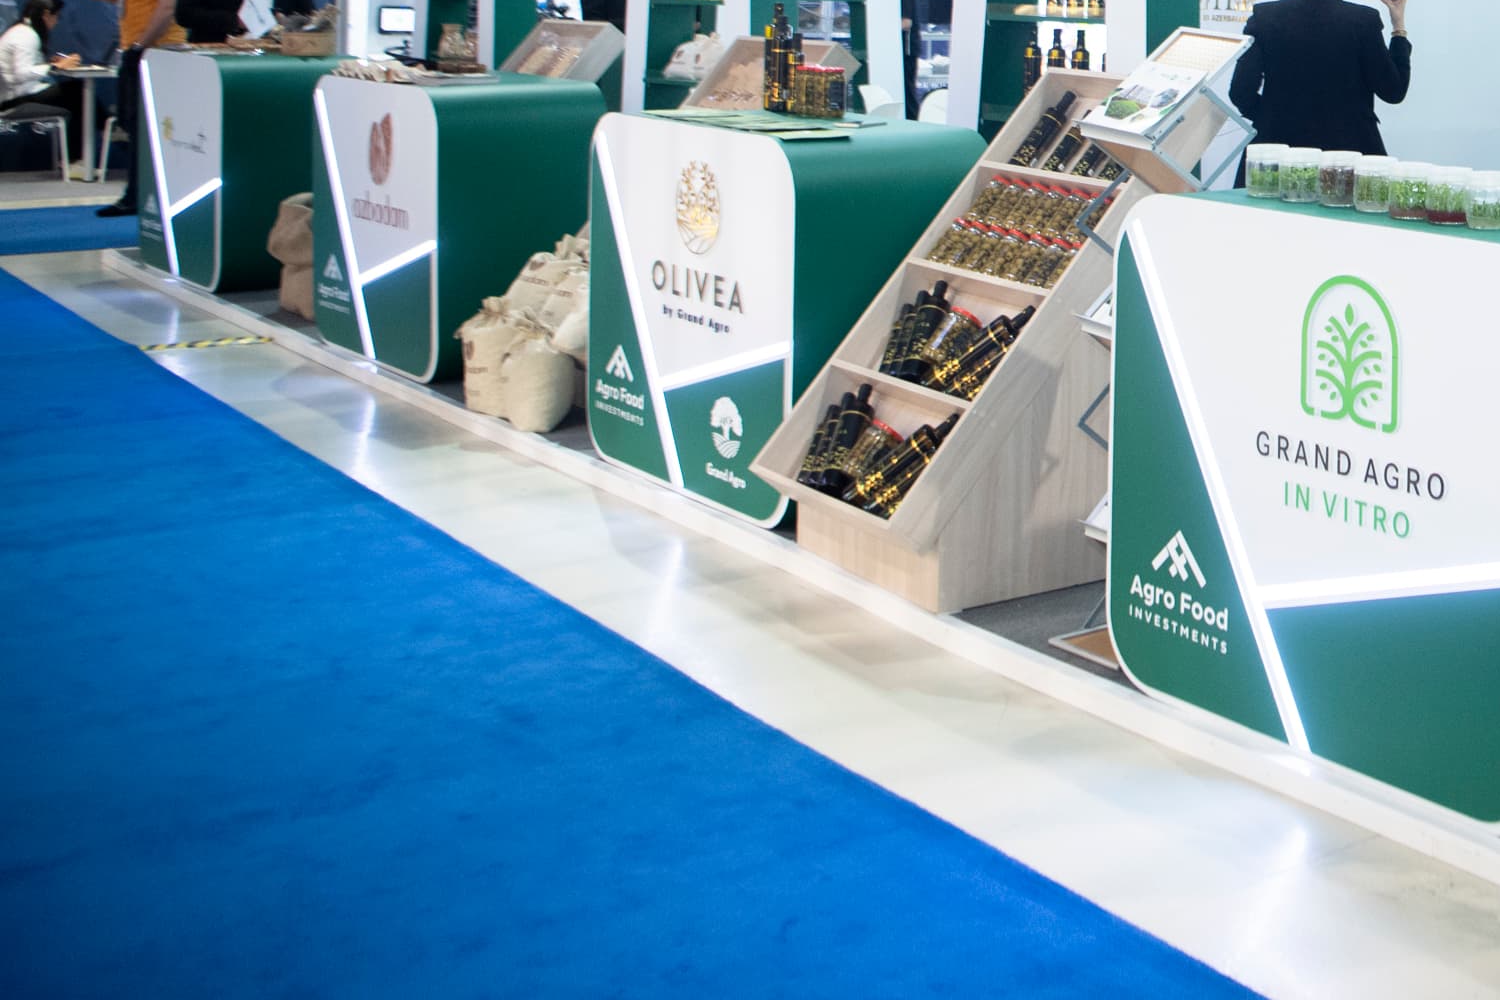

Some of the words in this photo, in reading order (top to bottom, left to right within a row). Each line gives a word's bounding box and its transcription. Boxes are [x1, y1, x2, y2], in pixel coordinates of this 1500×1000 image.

[652, 259, 745, 315] OLIVEA
[663, 303, 674, 318] by
[677, 308, 705, 326] Grand
[708, 317, 731, 334] Agro
[595, 378, 620, 403] Agro
[620, 386, 645, 411] Food
[1255, 430, 1352, 477] GRAND
[1363, 457, 1446, 501] AGRO
[1283, 481, 1311, 512] IN
[1322, 490, 1411, 539] VITRO
[1128, 603, 1228, 655] INVESTMENTS
[1130, 573, 1176, 610] Agro
[1180, 592, 1229, 632] Food
